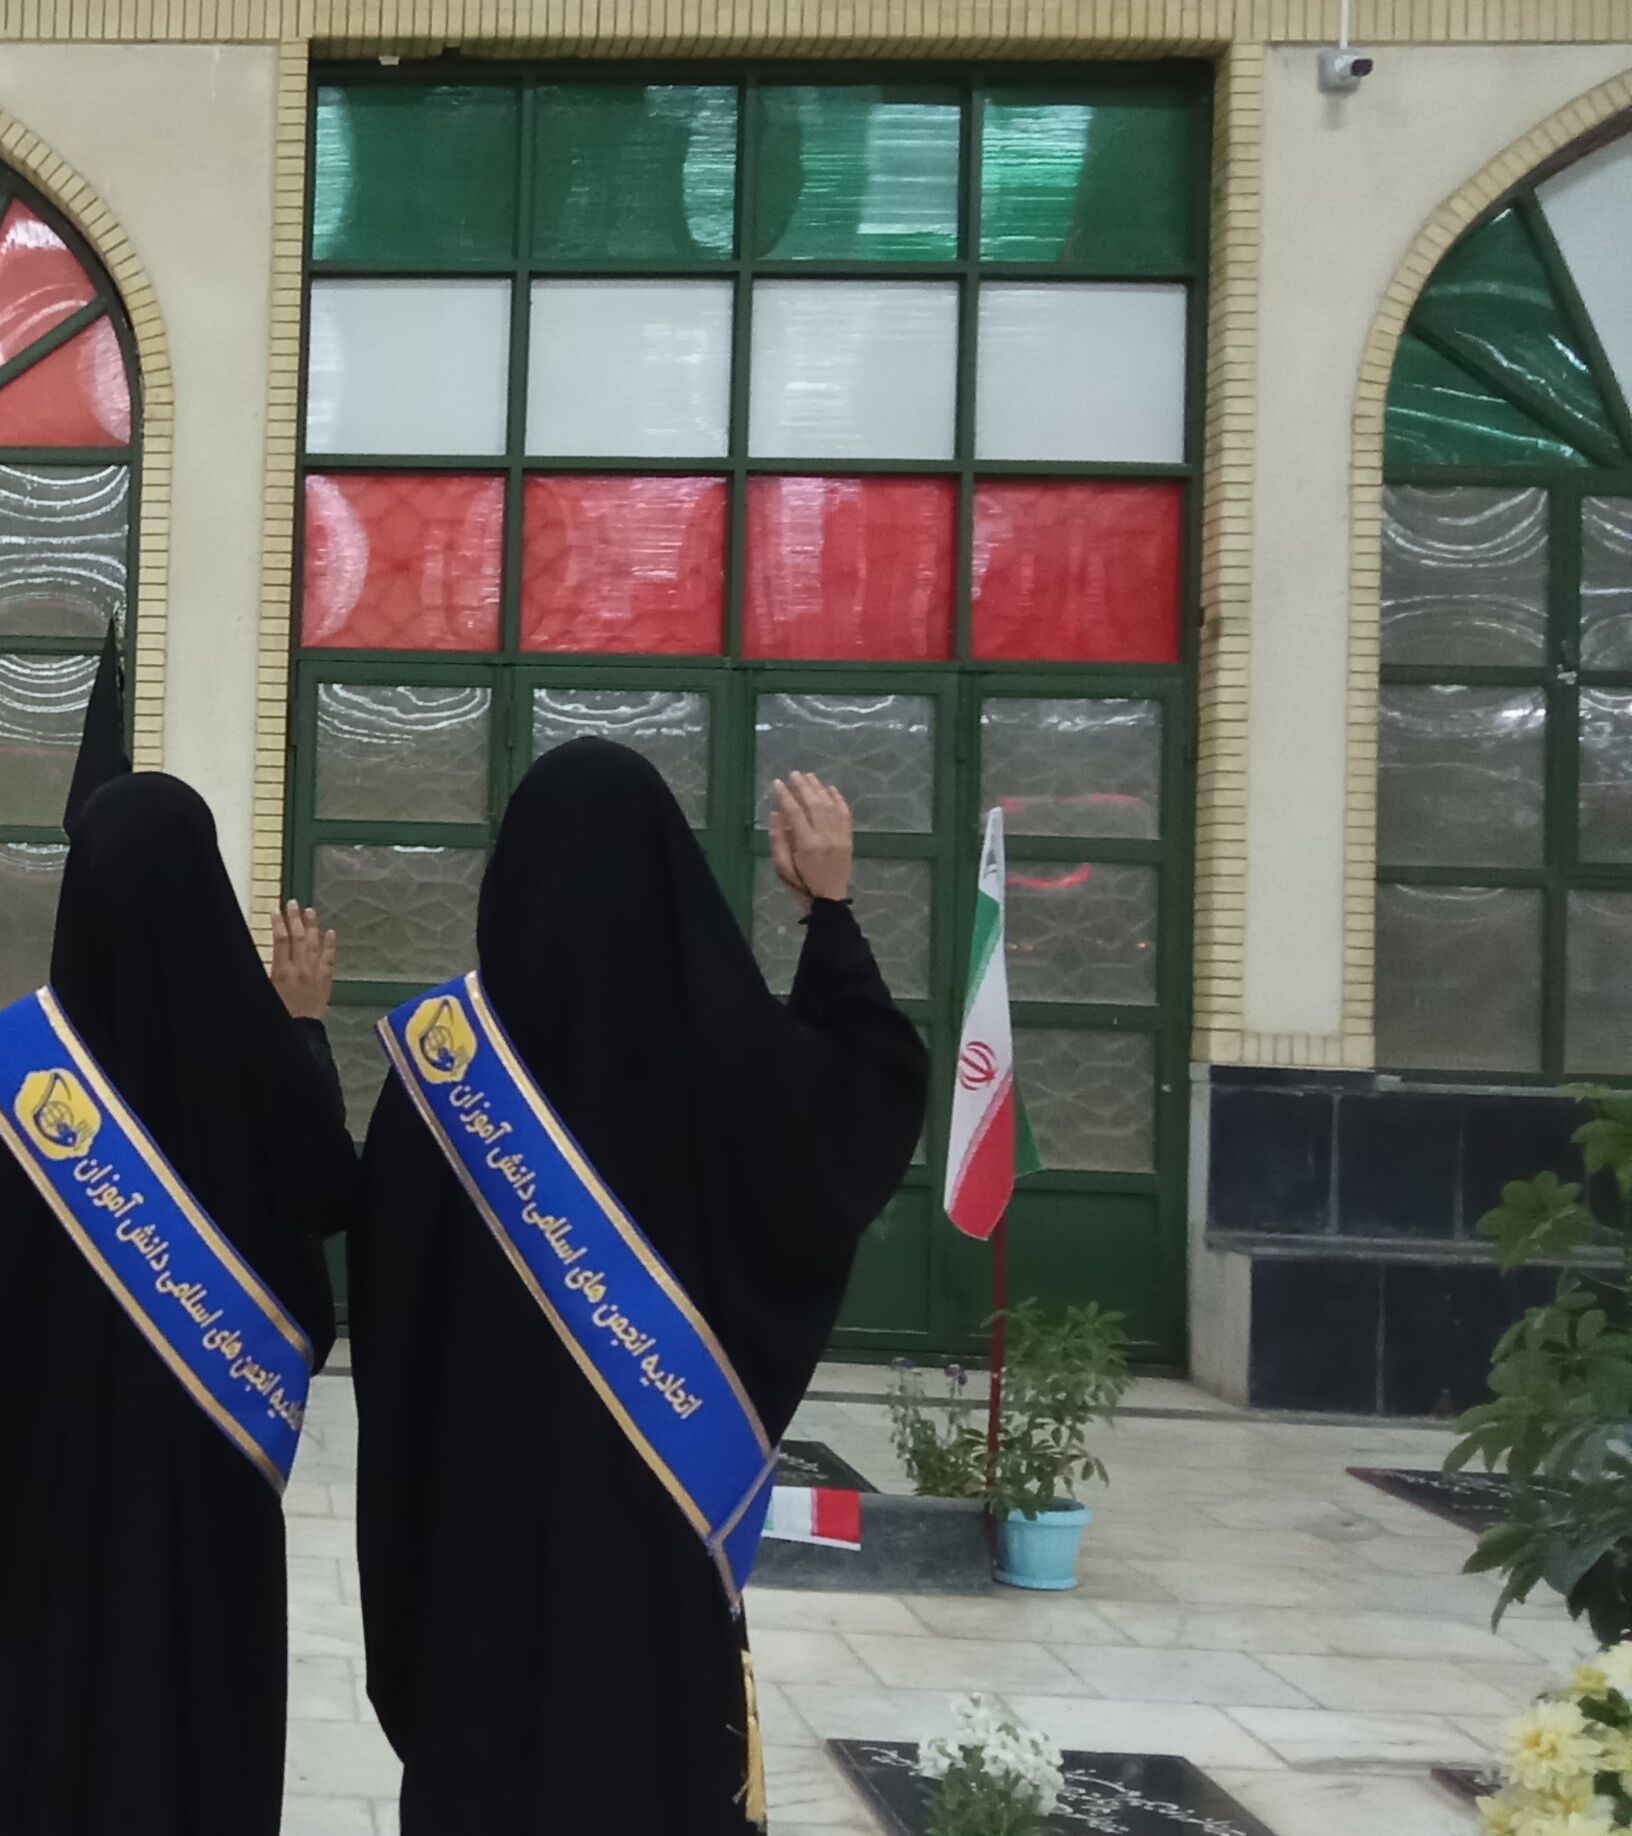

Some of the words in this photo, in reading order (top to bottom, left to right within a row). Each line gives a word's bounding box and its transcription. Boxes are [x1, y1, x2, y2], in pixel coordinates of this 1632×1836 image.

[449, 1085, 513, 1144] آموزان
[73, 1159, 144, 1218] آموزان
[486, 1147, 536, 1201] دانش
[115, 1218, 169, 1271] دانش
[521, 1202, 588, 1265] اسلامی
[155, 1271, 223, 1328] اسلامی
[564, 1267, 607, 1304] های
[202, 1328, 243, 1360] های
[591, 1304, 657, 1357] انجمن
[229, 1356, 281, 1396] انجمن
[640, 1353, 703, 1419] اتحادیه
